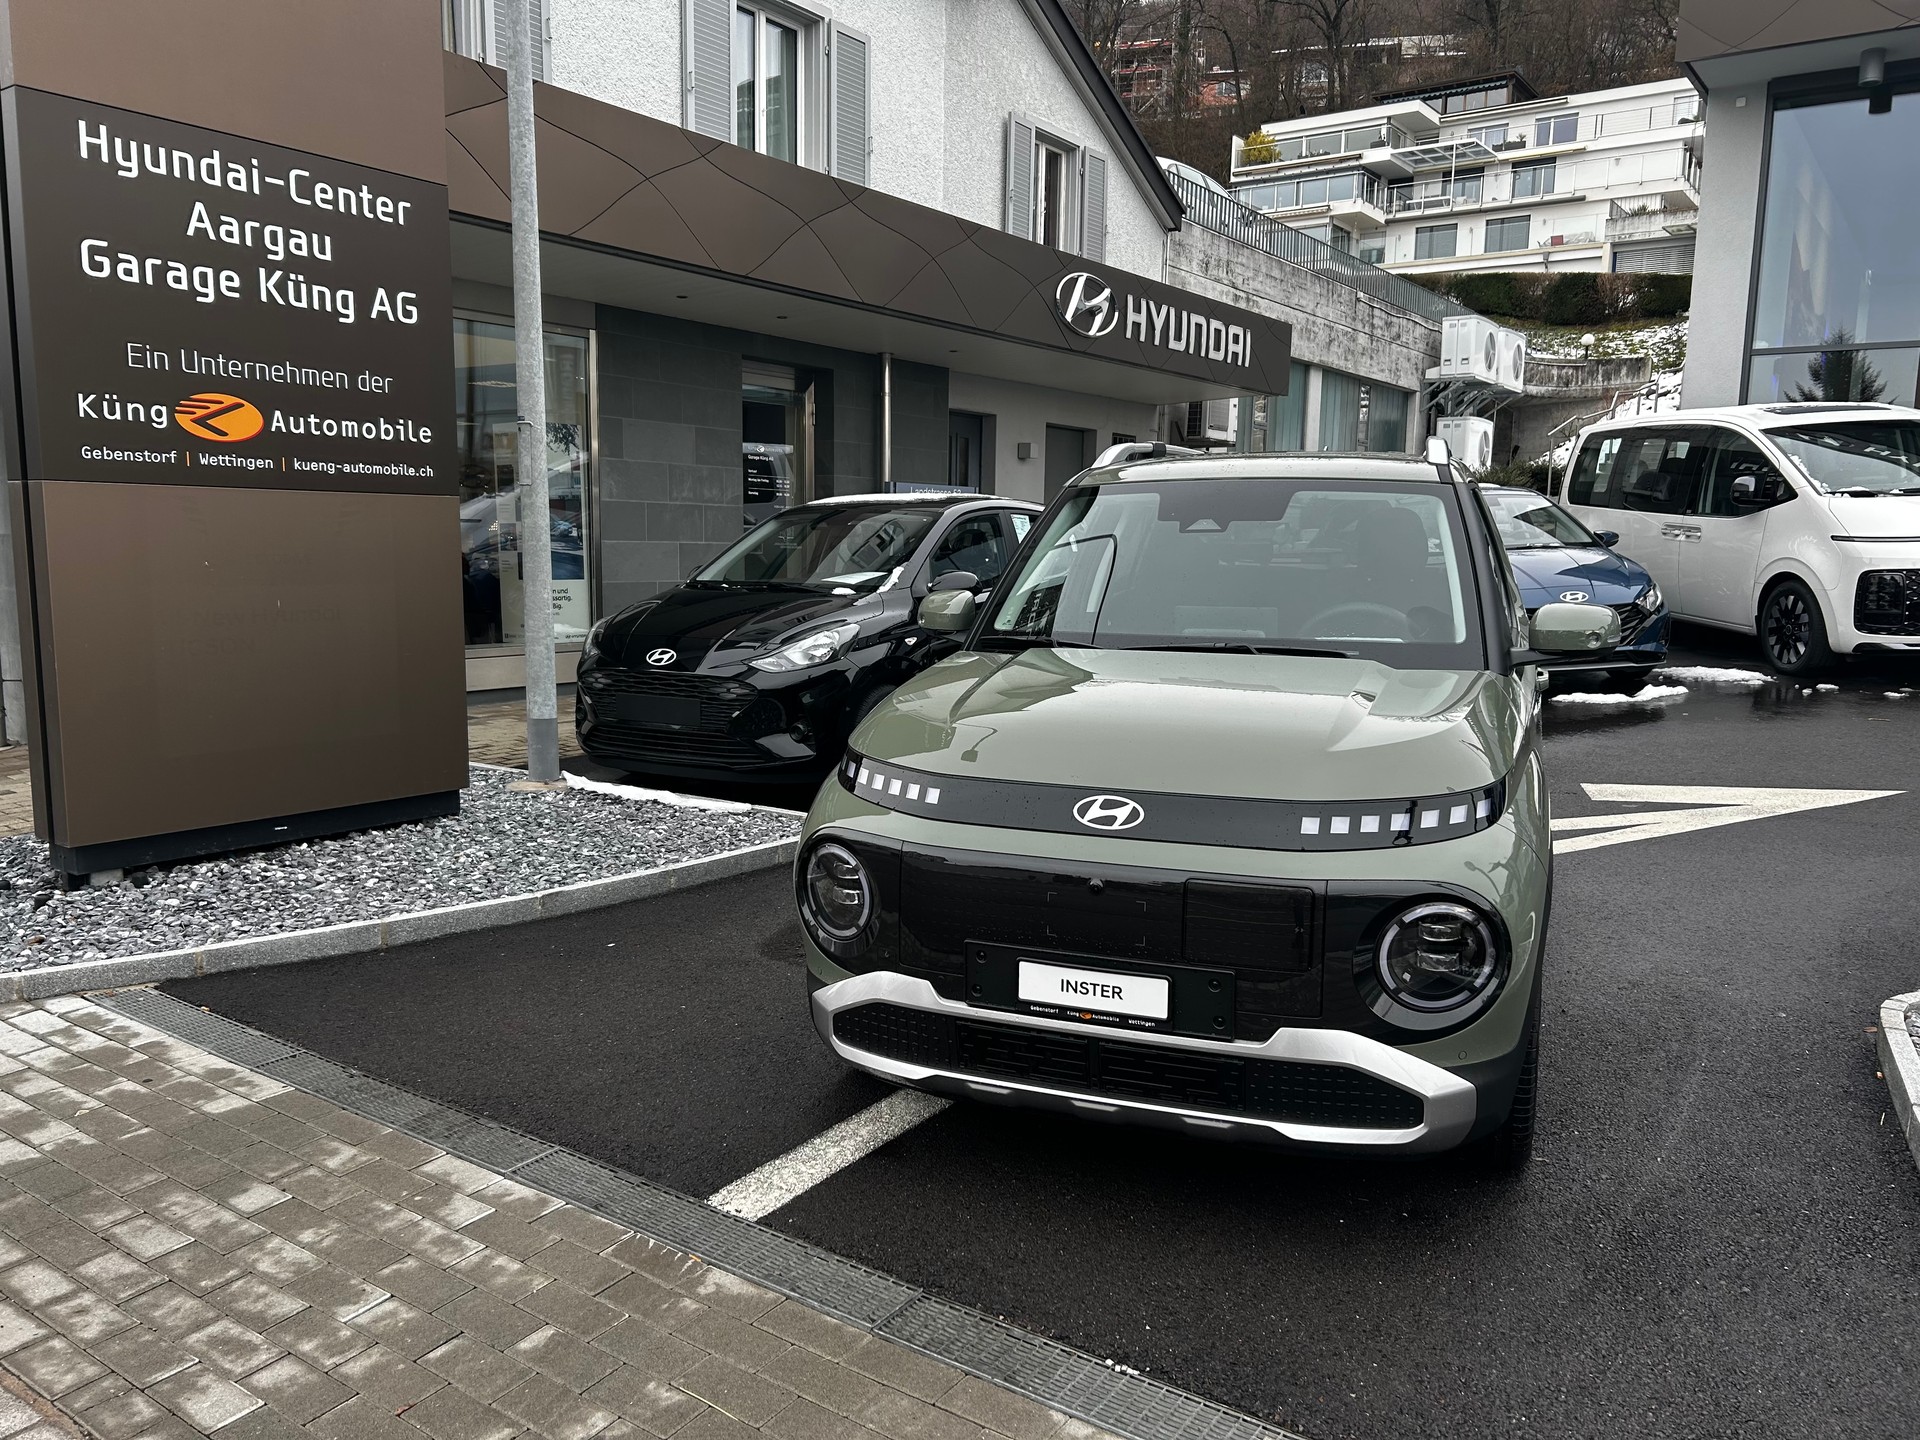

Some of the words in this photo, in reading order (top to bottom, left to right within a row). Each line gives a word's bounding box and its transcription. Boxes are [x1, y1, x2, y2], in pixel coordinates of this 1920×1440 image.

[77, 119, 412, 226] Hyundai-Center
[186, 201, 333, 262] Aargau
[80, 238, 241, 304] Garage
[258, 267, 355, 324] Küng
[370, 287, 418, 325] AG
[1125, 294, 1252, 369] HYUNDAI
[127, 342, 169, 371] Ein
[180, 348, 349, 390] Unternehmen
[357, 370, 394, 394] der
[77, 392, 168, 429] Küng
[270, 409, 433, 444] Automobile
[81, 445, 178, 464] Gebenstorf
[198, 452, 274, 471] Wettingen
[293, 457, 434, 477] kueng-automobile.ch
[1060, 978, 1124, 1001] INSTER
